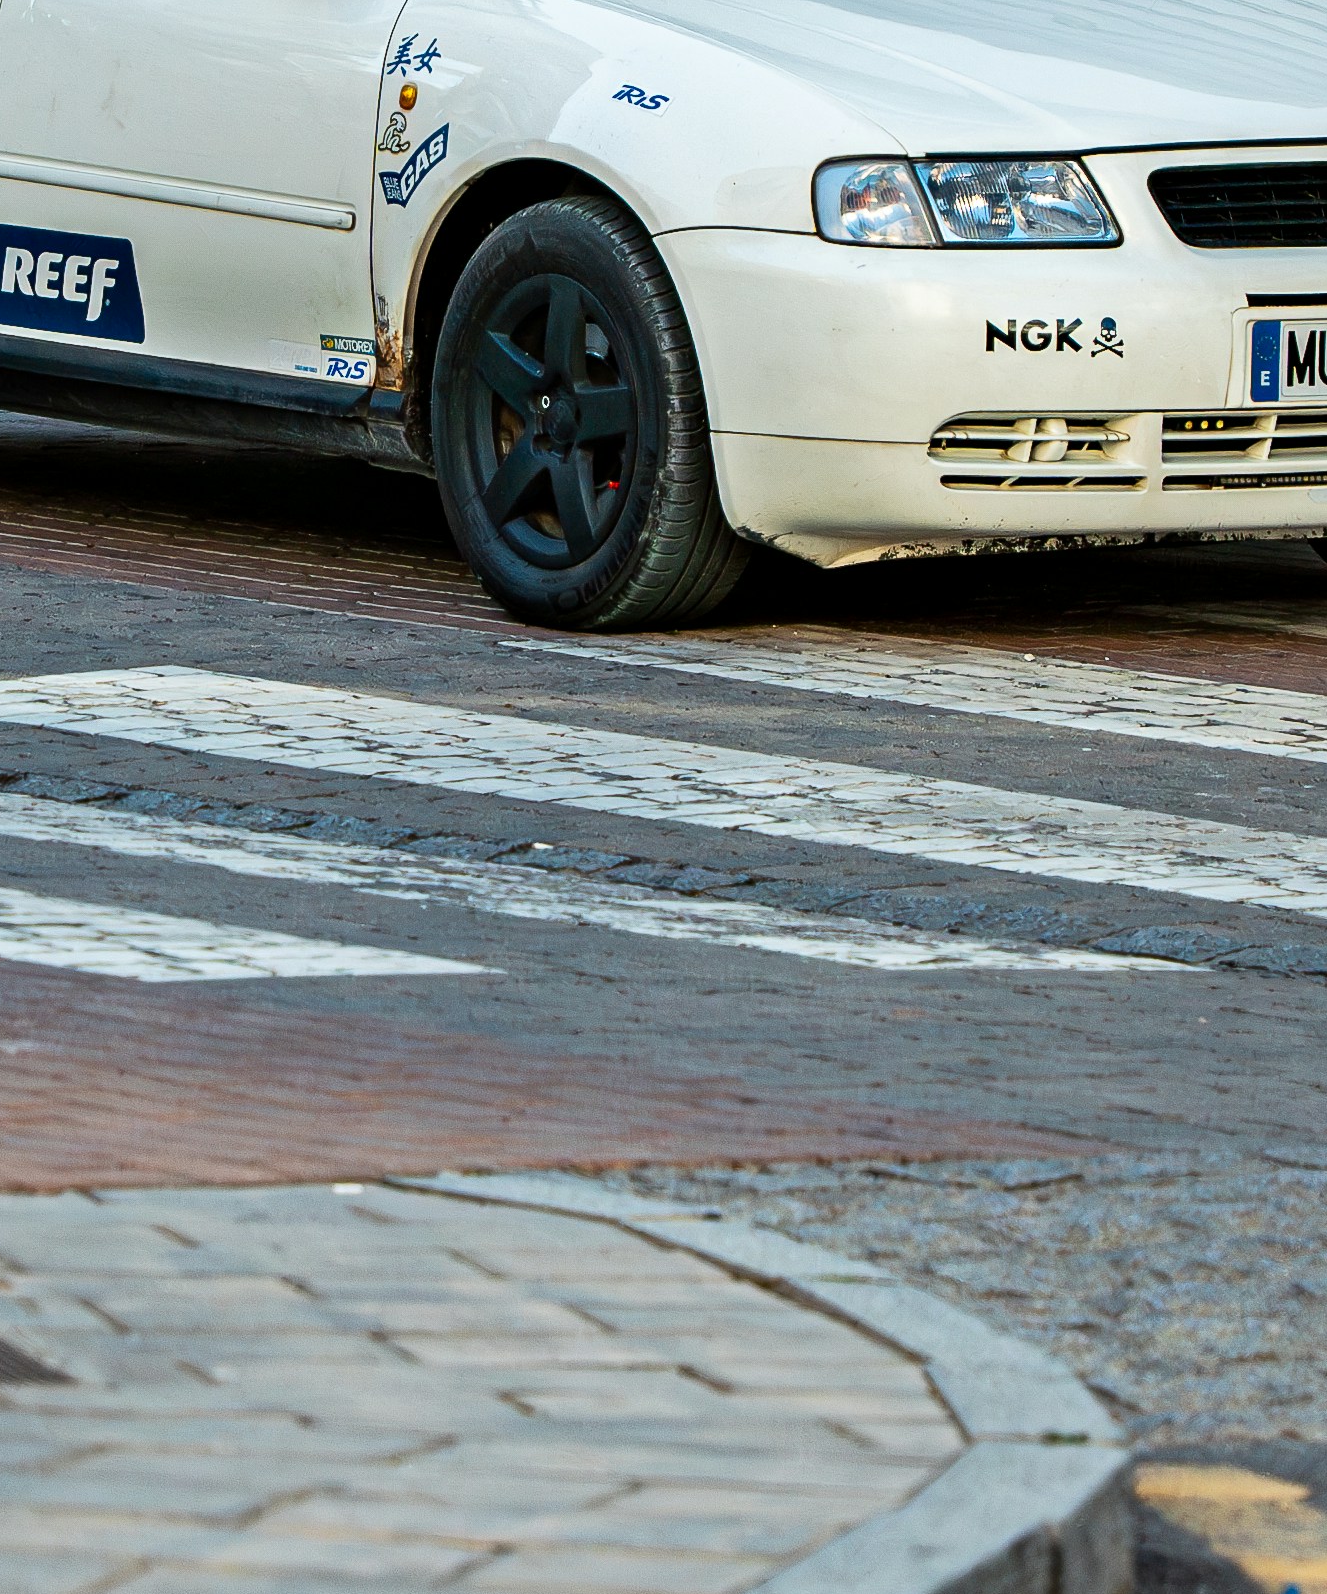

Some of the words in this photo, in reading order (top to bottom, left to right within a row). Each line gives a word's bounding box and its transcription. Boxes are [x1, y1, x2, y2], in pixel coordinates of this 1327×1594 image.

[386, 33, 441, 77] 美女
[400, 133, 445, 201] GAS
[1, 246, 120, 321] REEF
[334, 338, 374, 353] MOTOREX
[985, 318, 1083, 352] NGK
[1260, 370, 1271, 387] E
